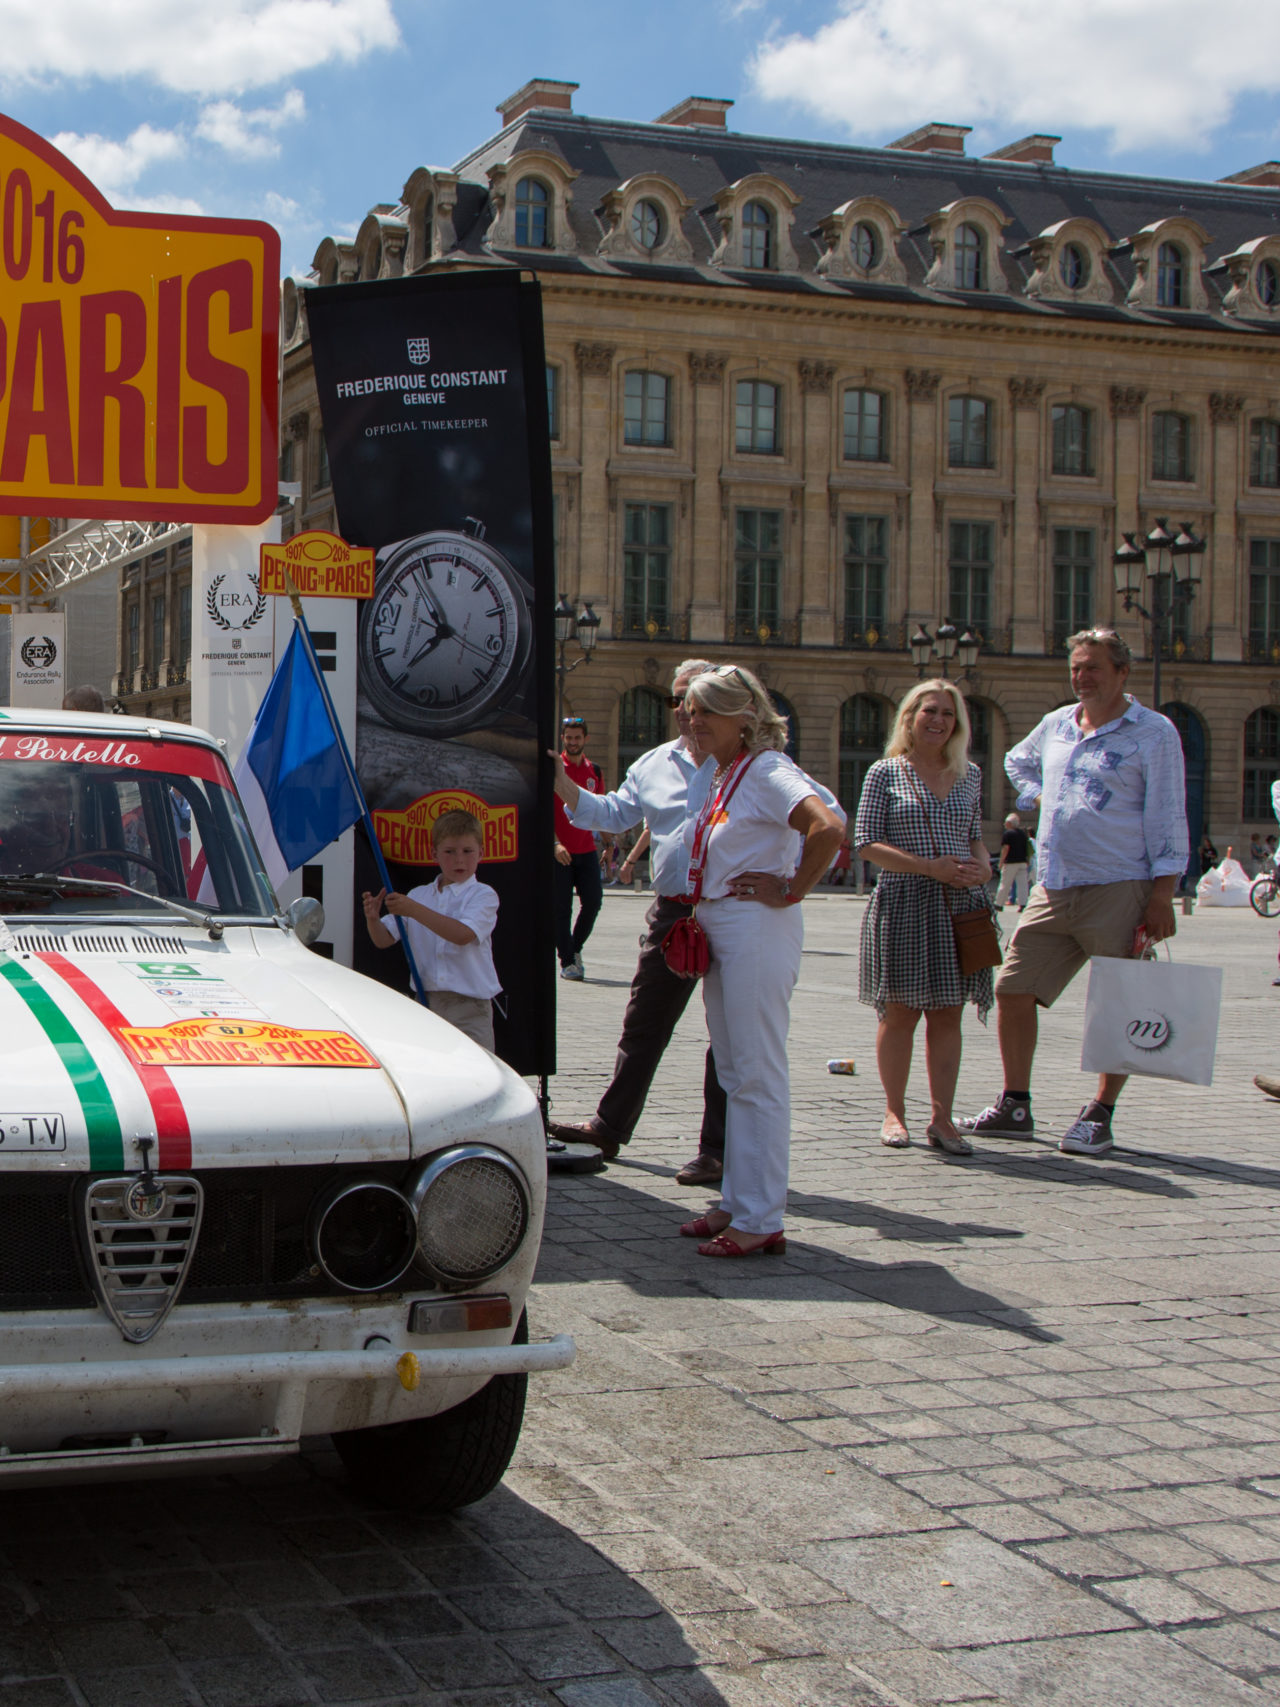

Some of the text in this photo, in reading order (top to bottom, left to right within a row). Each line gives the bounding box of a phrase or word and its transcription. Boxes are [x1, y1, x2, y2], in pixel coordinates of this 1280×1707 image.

[336, 369, 508, 399] FREDERIQUE CONSTANT
[402, 391, 446, 406] GENEVE
[364, 417, 489, 438] OFFICIAL TIMEKEEPER
[285, 542, 350, 563] 1907 2016
[325, 559, 371, 594] PARIS
[220, 593, 254, 607] ERA
[26, 646, 52, 658] ERA
[14, 736, 142, 765] Portello
[406, 802, 428, 826] 1907
[376, 812, 515, 861] PEKIN RIS
[168, 1025, 304, 1039] 1907 67 2016
[128, 1033, 368, 1063] PEKING TO PARIS
[21, 1119, 60, 1147] TV
